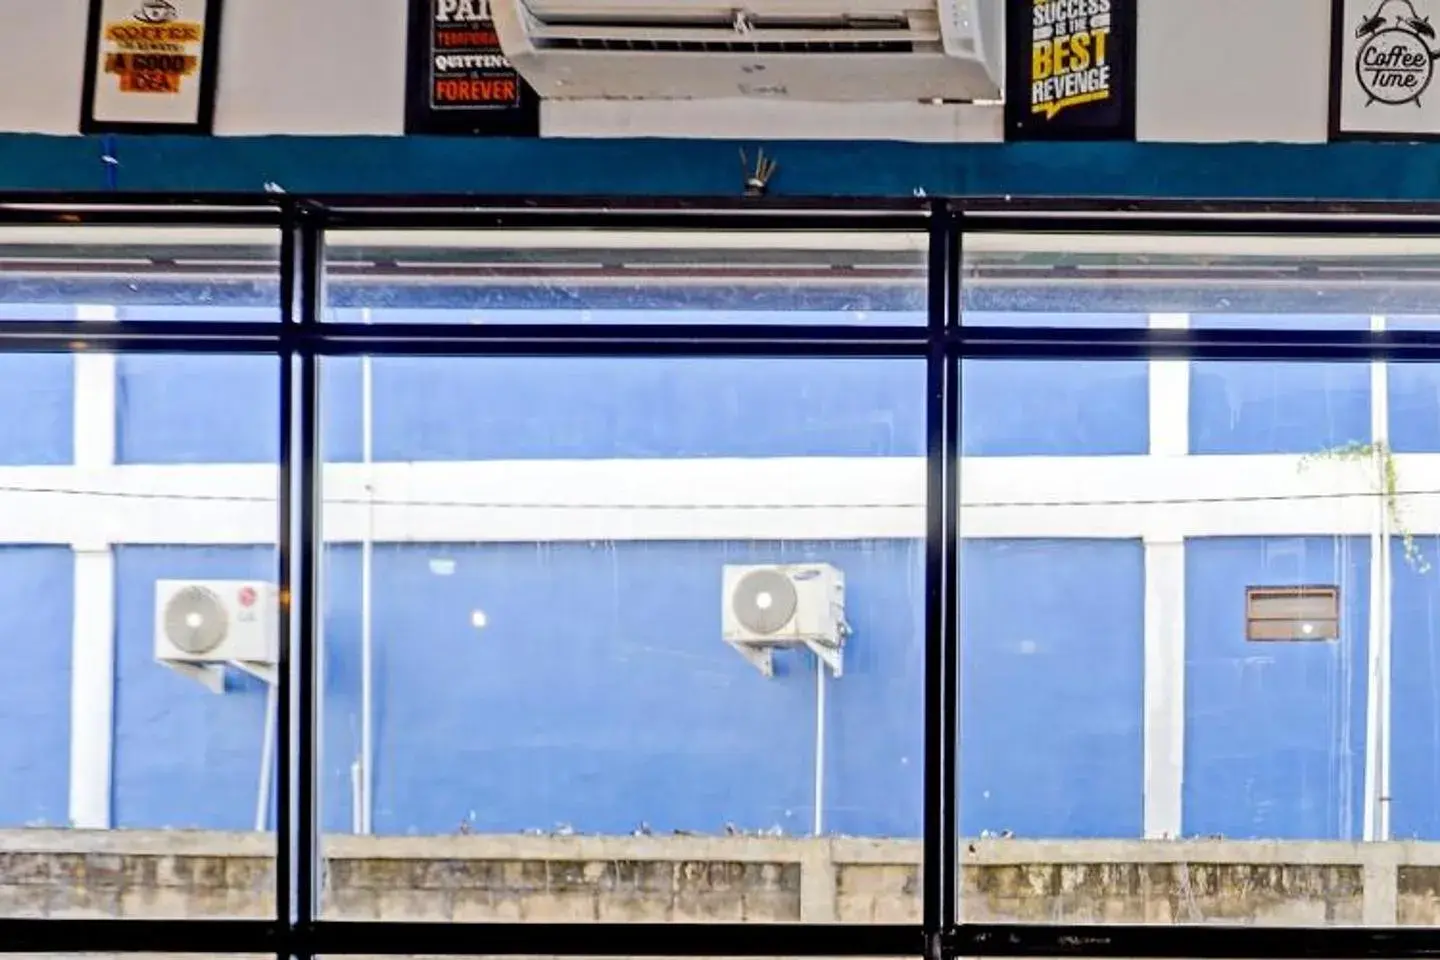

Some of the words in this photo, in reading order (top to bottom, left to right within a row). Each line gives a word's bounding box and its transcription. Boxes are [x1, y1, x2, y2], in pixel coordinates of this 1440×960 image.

[435, 0, 491, 21] PAI
[1032, 0, 1110, 26] SUCCESS
[1032, 28, 1110, 80] BEST
[1363, 46, 1427, 67] Coffee
[1032, 66, 1110, 104] REVENGE
[1368, 68, 1419, 88] Time
[437, 80, 514, 101] FOREVER
